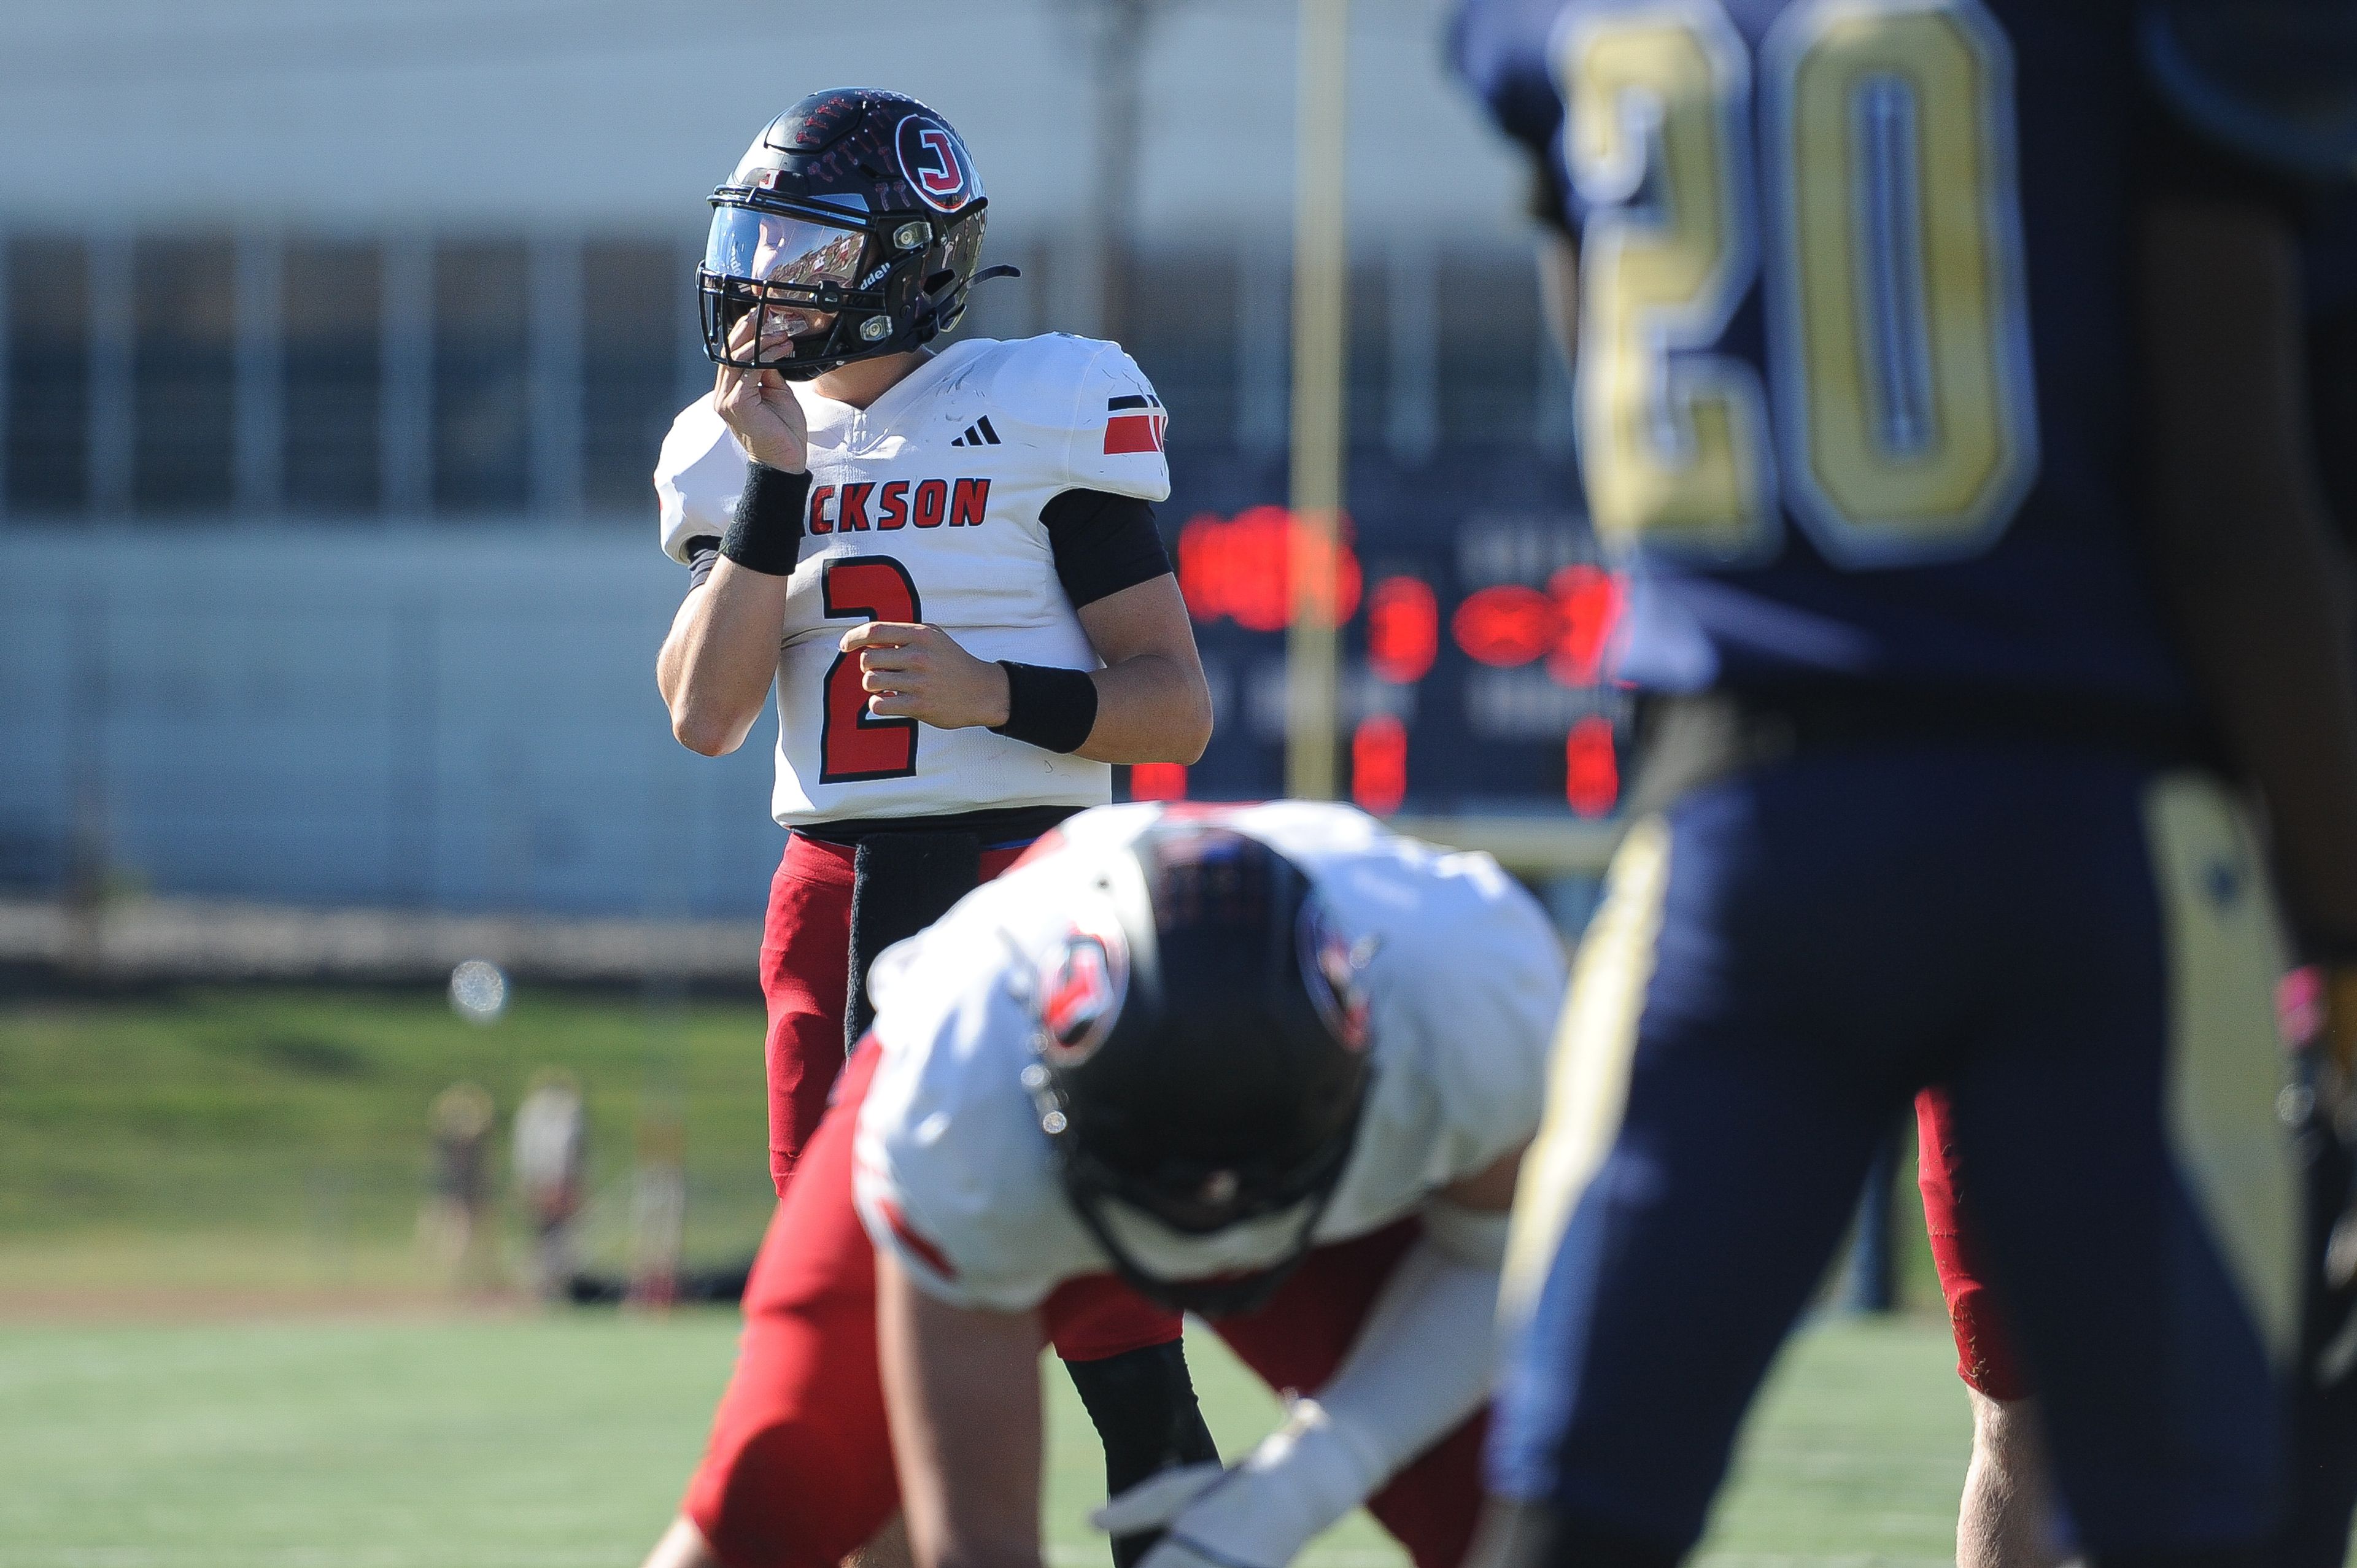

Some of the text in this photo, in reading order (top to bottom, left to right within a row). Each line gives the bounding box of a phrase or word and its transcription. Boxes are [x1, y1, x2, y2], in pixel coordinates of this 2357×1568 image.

[918, 129, 964, 195] J
[859, 262, 891, 290] ddell
[1549, 0, 2038, 568] 20
[805, 477, 993, 536] CKSON
[819, 554, 923, 785] 2
